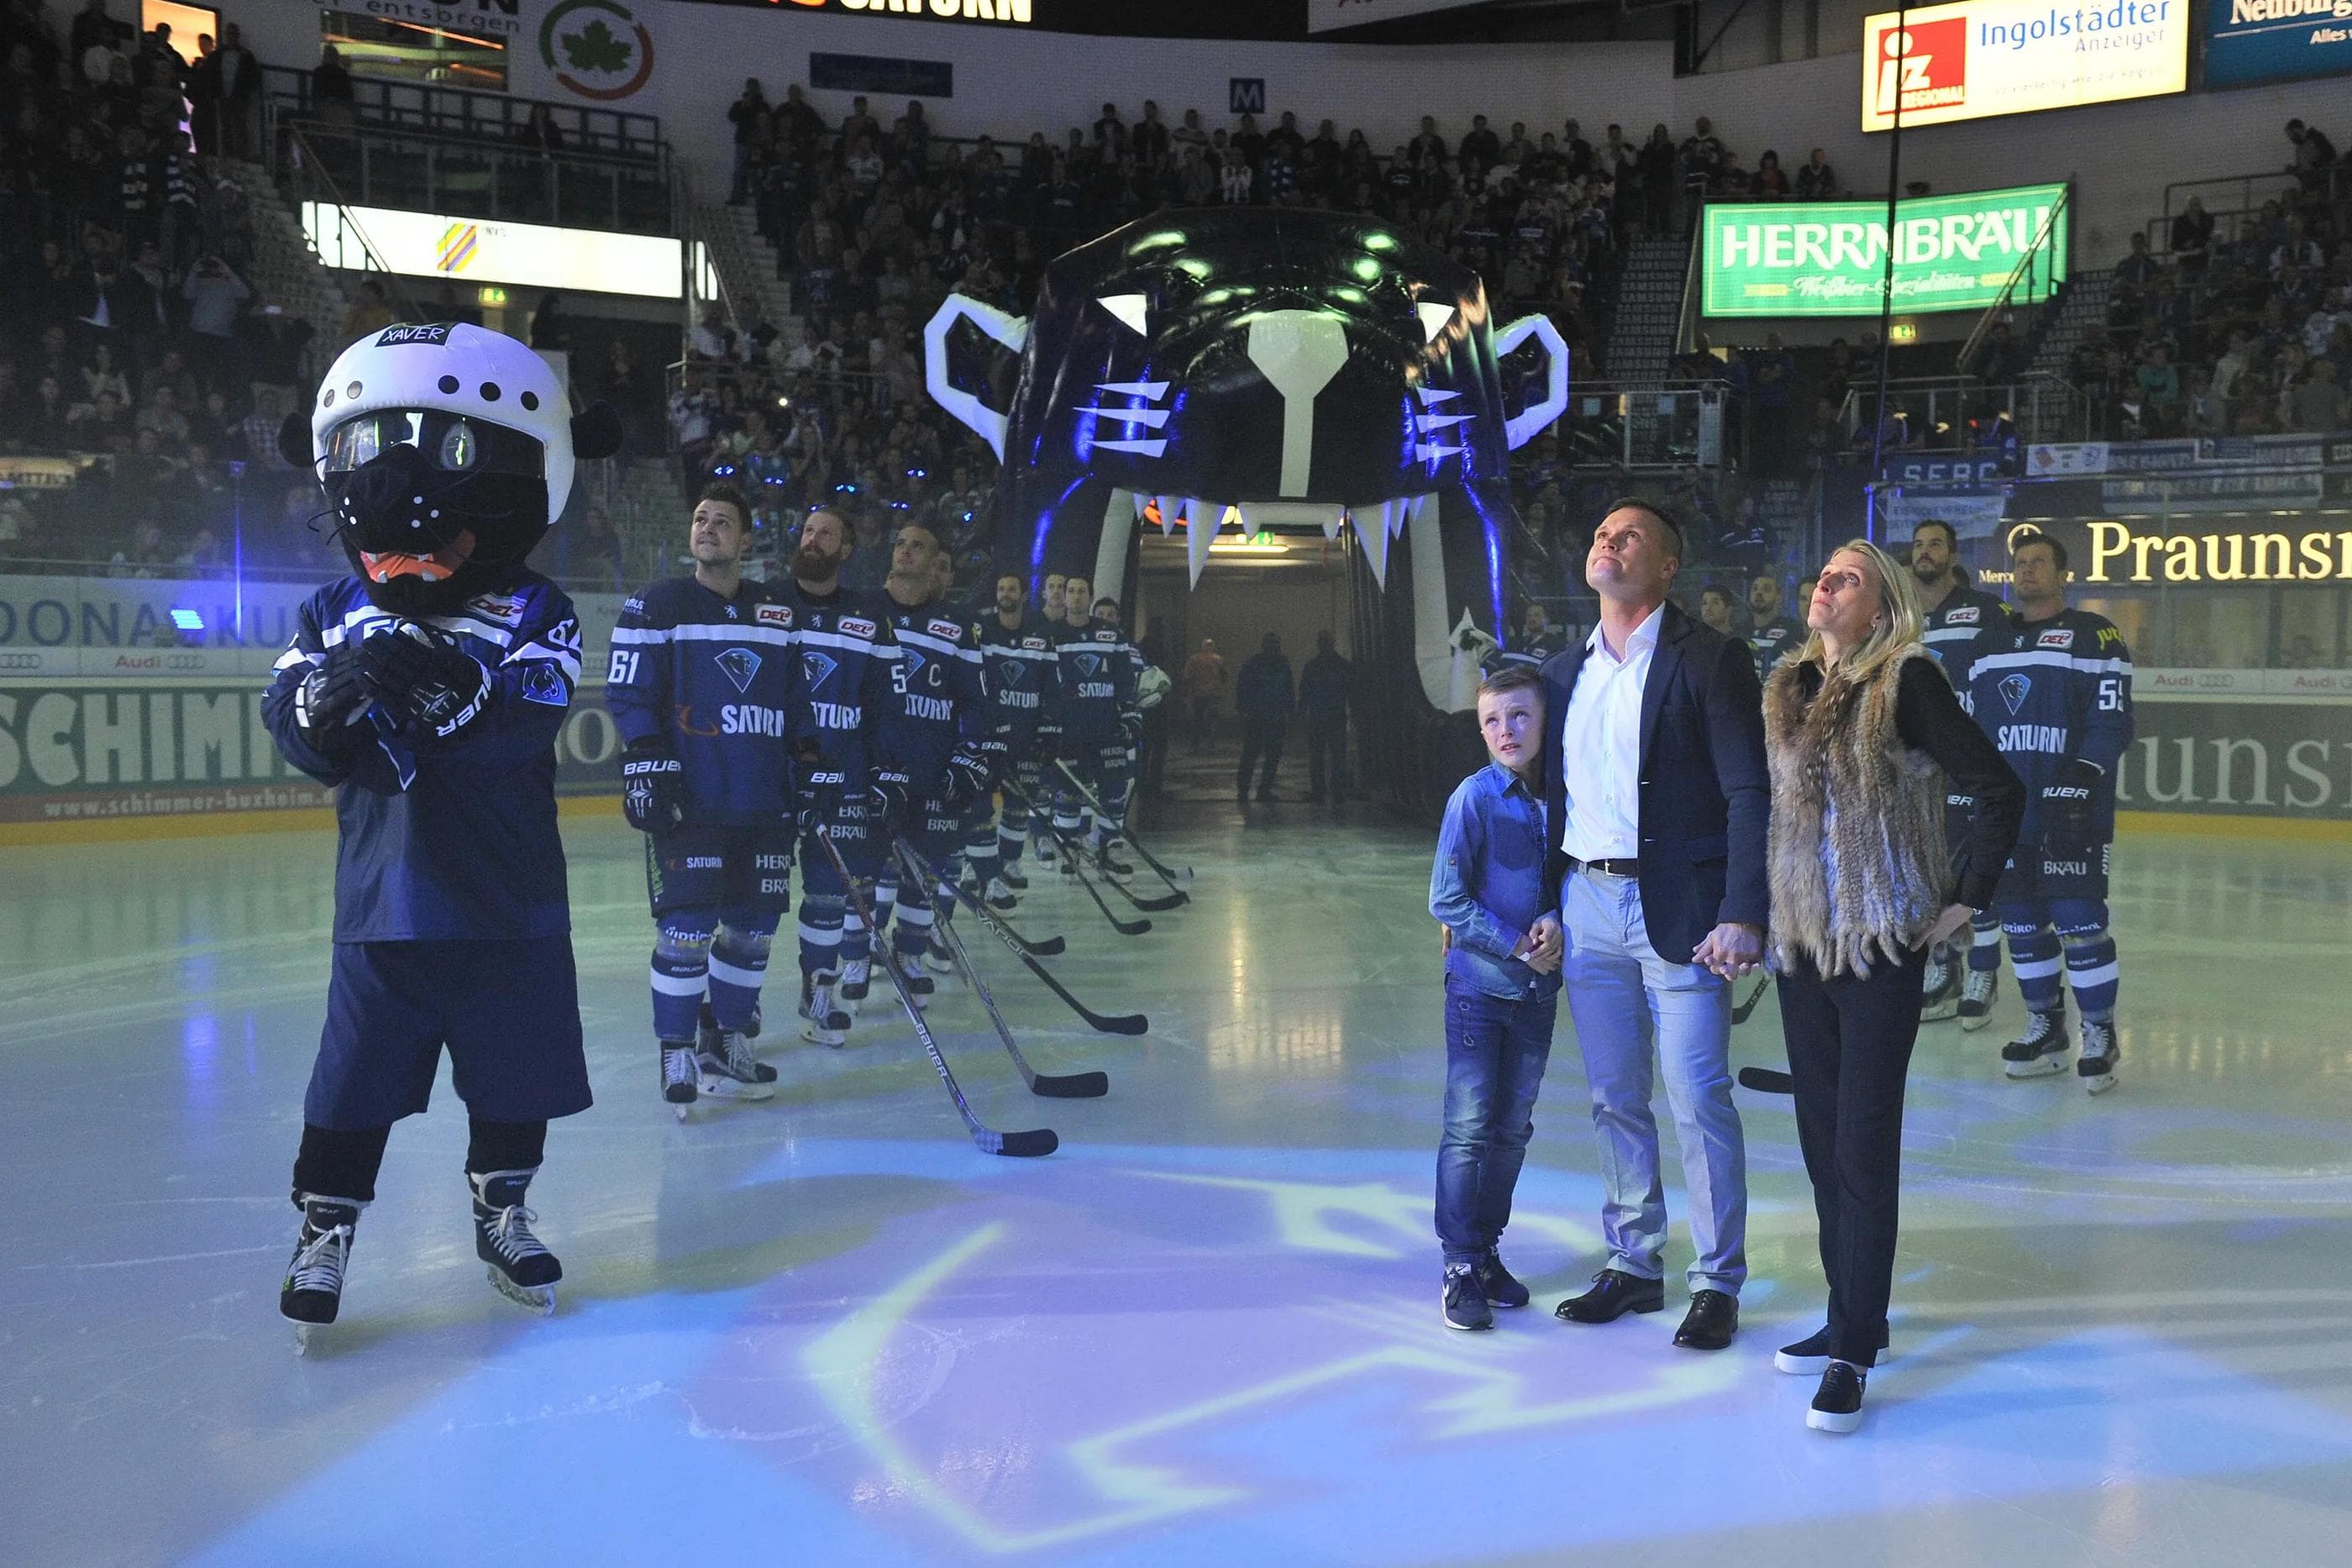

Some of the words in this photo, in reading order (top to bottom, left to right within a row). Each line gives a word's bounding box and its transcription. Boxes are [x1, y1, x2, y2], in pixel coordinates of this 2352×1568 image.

[366, 1, 520, 34] entsorgen
[1981, 0, 2171, 50] Ingolstädter
[2075, 29, 2165, 53] Anzeiger
[1721, 205, 2050, 270] HERRNBRÄU
[382, 327, 444, 342] XAVER
[115, 655, 161, 669] Audi
[607, 650, 640, 684] 61
[928, 663, 942, 687] C
[2155, 674, 2193, 687] Audi
[2294, 675, 2335, 687] Audi
[1998, 725, 2068, 754] SATURN
[2115, 735, 2352, 809] uns
[44, 789, 338, 817] www.schimmer-buxheim.d
[914, 1022, 948, 1079] BAUER
